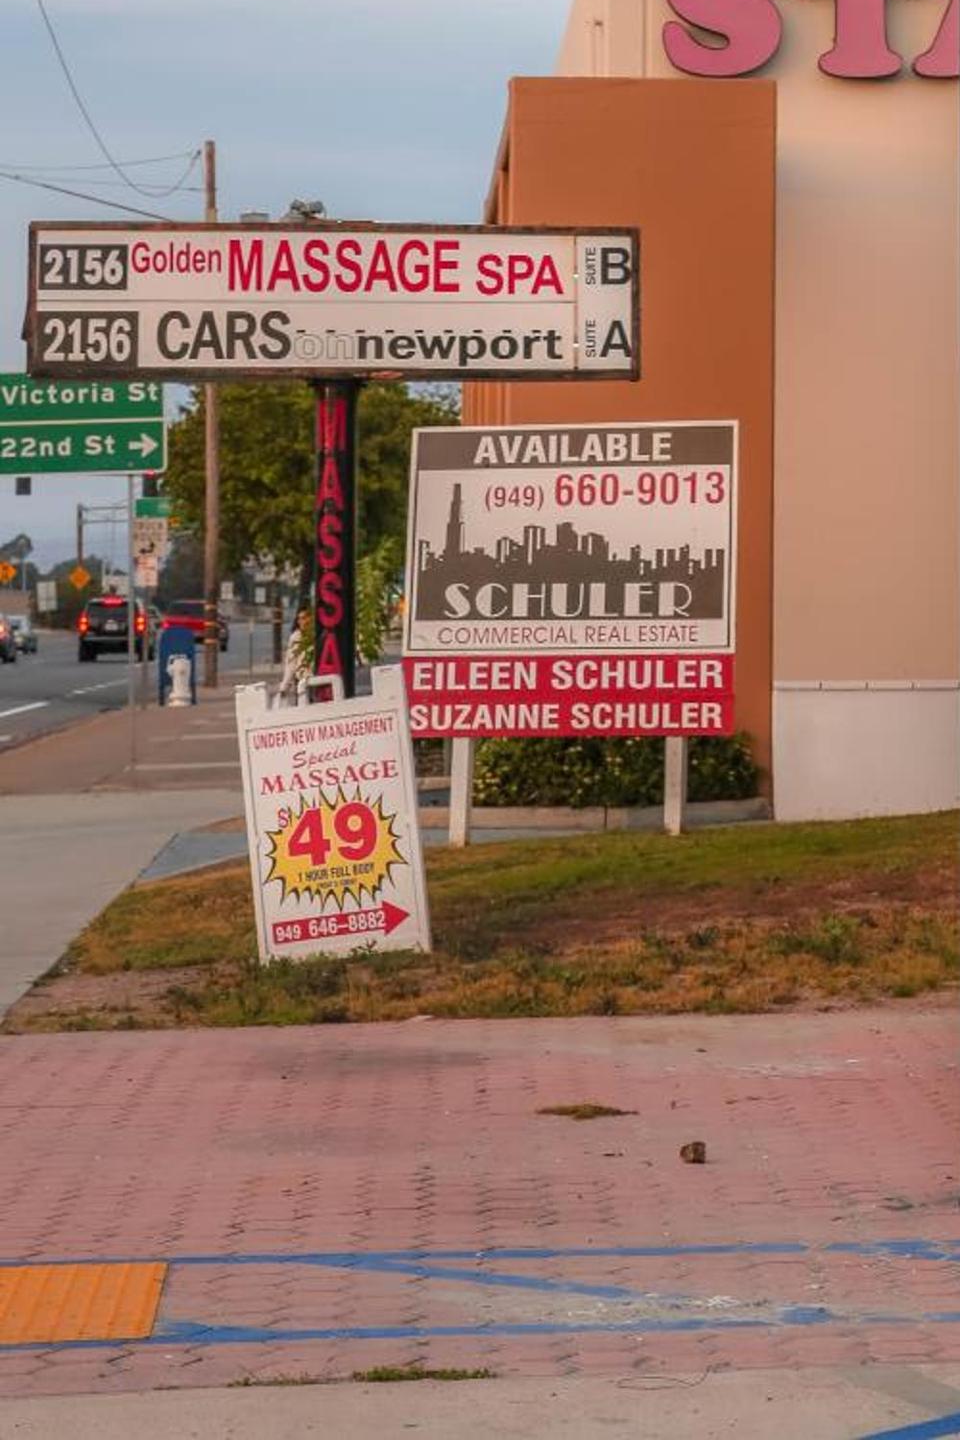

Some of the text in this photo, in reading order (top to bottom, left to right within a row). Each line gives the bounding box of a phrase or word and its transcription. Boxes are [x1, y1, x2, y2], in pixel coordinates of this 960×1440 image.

[44, 239, 564, 296] 2156 Golden MASSAGE SPA
[585, 246, 597, 285] SUITE
[600, 247, 631, 285] B
[43, 318, 132, 362] 2156
[157, 311, 291, 360] CARS
[357, 329, 562, 366] newport
[585, 319, 597, 358] SUITE
[598, 320, 632, 358] A
[1, 382, 160, 406] Victoria St
[1, 434, 116, 458] 22nd St
[474, 432, 672, 465] AVAILABLE
[485, 471, 726, 511] (949) 660-9013
[444, 581, 693, 619] SCHULER
[437, 625, 699, 644] COMMERCIAL REAL ESTATE
[412, 659, 724, 691] EILEEN SCHULER
[253, 717, 393, 750] UNDER NEW MANAGEMENT
[410, 702, 723, 731] SUZANNE SCHULER
[292, 740, 358, 769] Special
[260, 759, 399, 796] MASSAGE
[275, 923, 301, 942] 949
